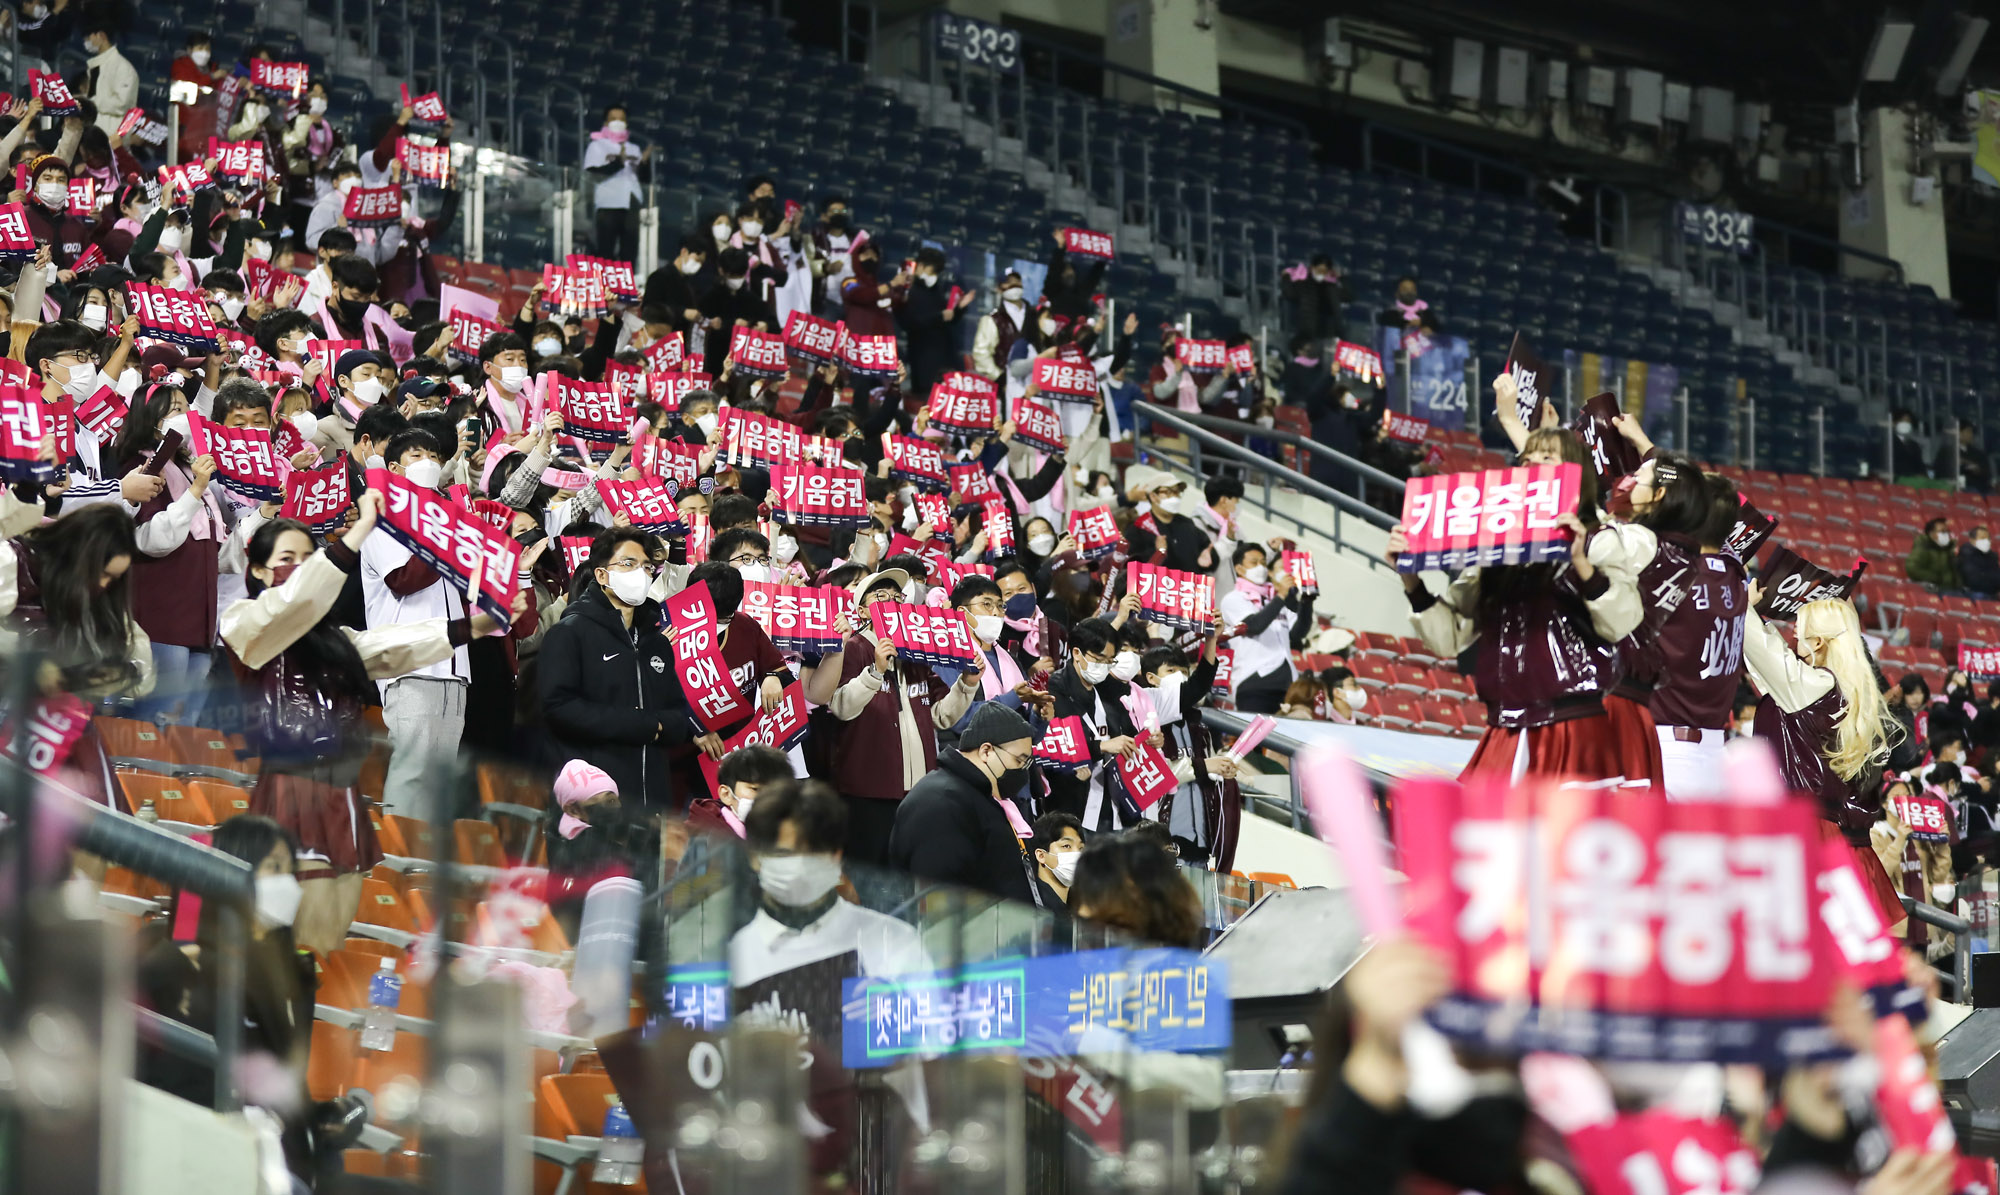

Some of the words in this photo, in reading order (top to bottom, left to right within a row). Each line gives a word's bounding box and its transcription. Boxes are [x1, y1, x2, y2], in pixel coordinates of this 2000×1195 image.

[964, 24, 1016, 68] 333
[65, 185, 93, 211] 권
[352, 191, 398, 217] 키움증권
[0, 211, 29, 242] 권
[1703, 209, 1750, 249] 334
[453, 317, 494, 350] 키움
[734, 334, 785, 366] 키움증권
[789, 318, 837, 353] 키움증권
[1041, 364, 1099, 392] 키움증권
[1429, 378, 1469, 412] 224
[559, 385, 623, 423] 키움증권
[936, 392, 992, 423] 키움증권
[726, 416, 801, 462] 키움증권
[1020, 406, 1063, 442] 키움증권
[892, 441, 943, 476] 키움증권
[783, 474, 864, 509] 키움증권
[1408, 477, 1562, 540] 키움증권
[388, 482, 516, 596] 키움증권
[738, 590, 828, 631] 움증권
[1138, 572, 1213, 615] 키움증권
[1691, 584, 1710, 610] 김
[884, 611, 971, 650] 키움증권
[678, 599, 739, 720] 키움증권
[1450, 815, 1812, 985] 키움증권
